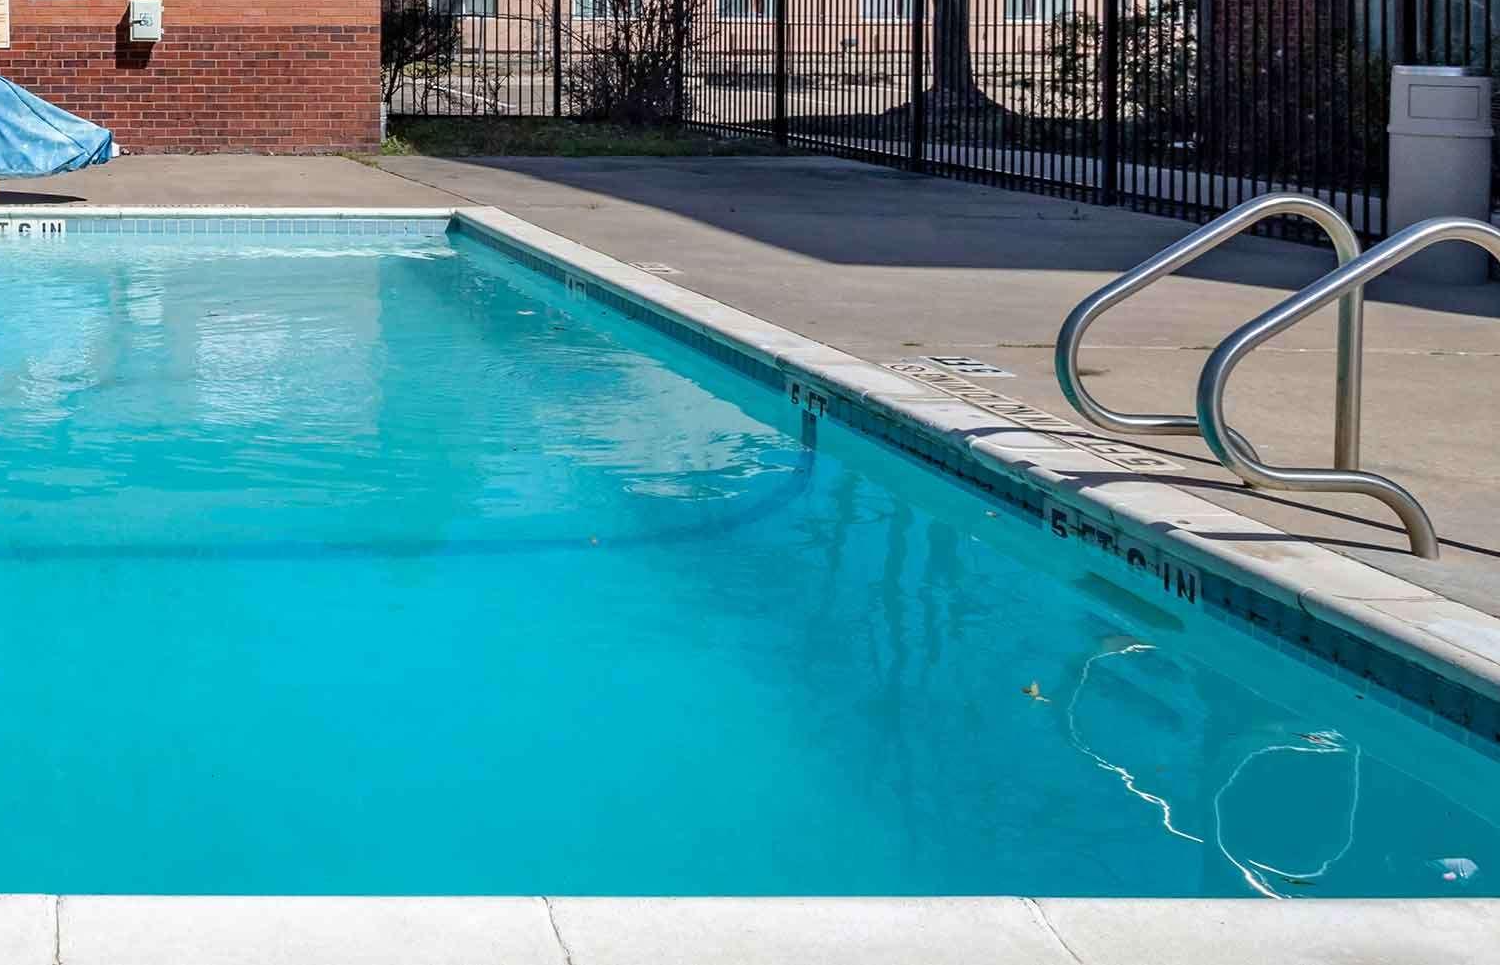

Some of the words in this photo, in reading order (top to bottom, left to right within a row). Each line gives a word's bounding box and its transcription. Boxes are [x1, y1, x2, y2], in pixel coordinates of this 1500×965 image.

[42, 222, 62, 238] IN
[1051, 508, 1068, 539] 5
[1164, 562, 1196, 604] IN
